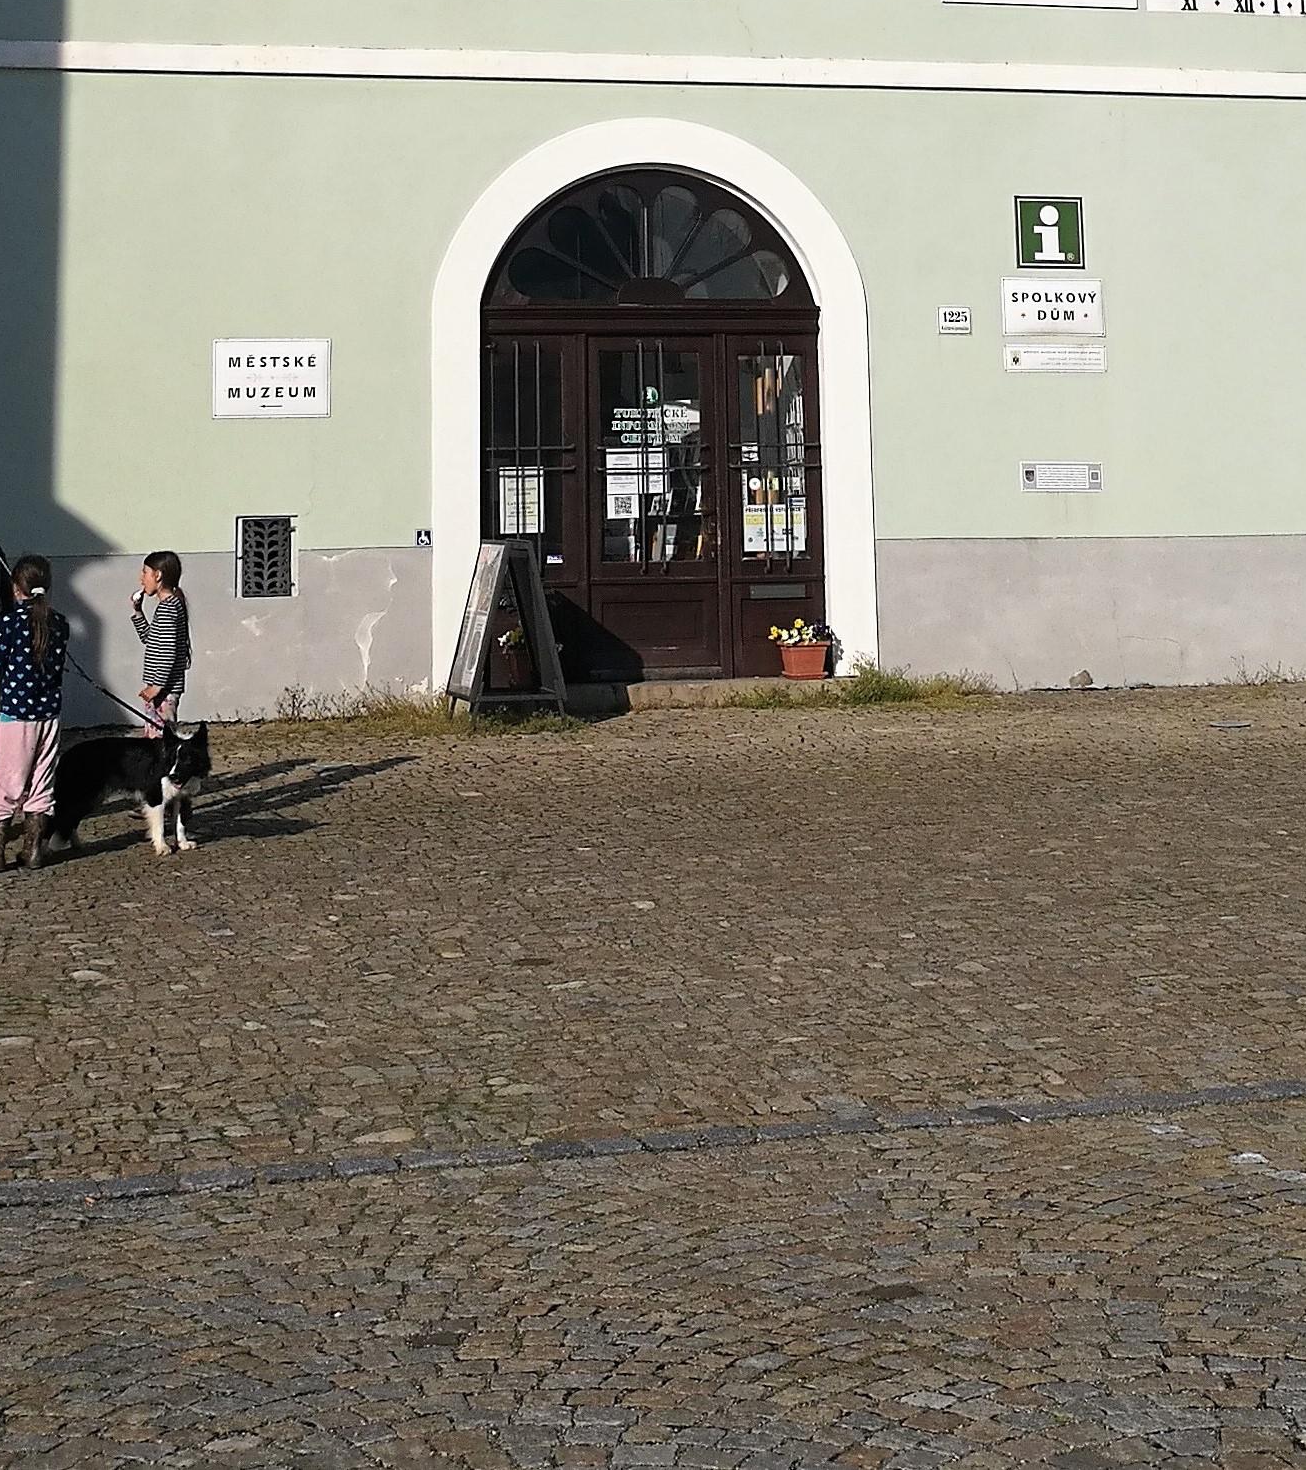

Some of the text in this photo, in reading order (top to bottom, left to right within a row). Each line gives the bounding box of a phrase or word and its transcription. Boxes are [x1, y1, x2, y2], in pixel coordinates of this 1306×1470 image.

[1011, 291, 1097, 304] SPOLKOVÝ
[942, 310, 968, 323] 1225
[1037, 307, 1075, 321] DŮM
[228, 354, 317, 368] MĚSTSKÉ
[228, 386, 316, 399] MUZEUM
